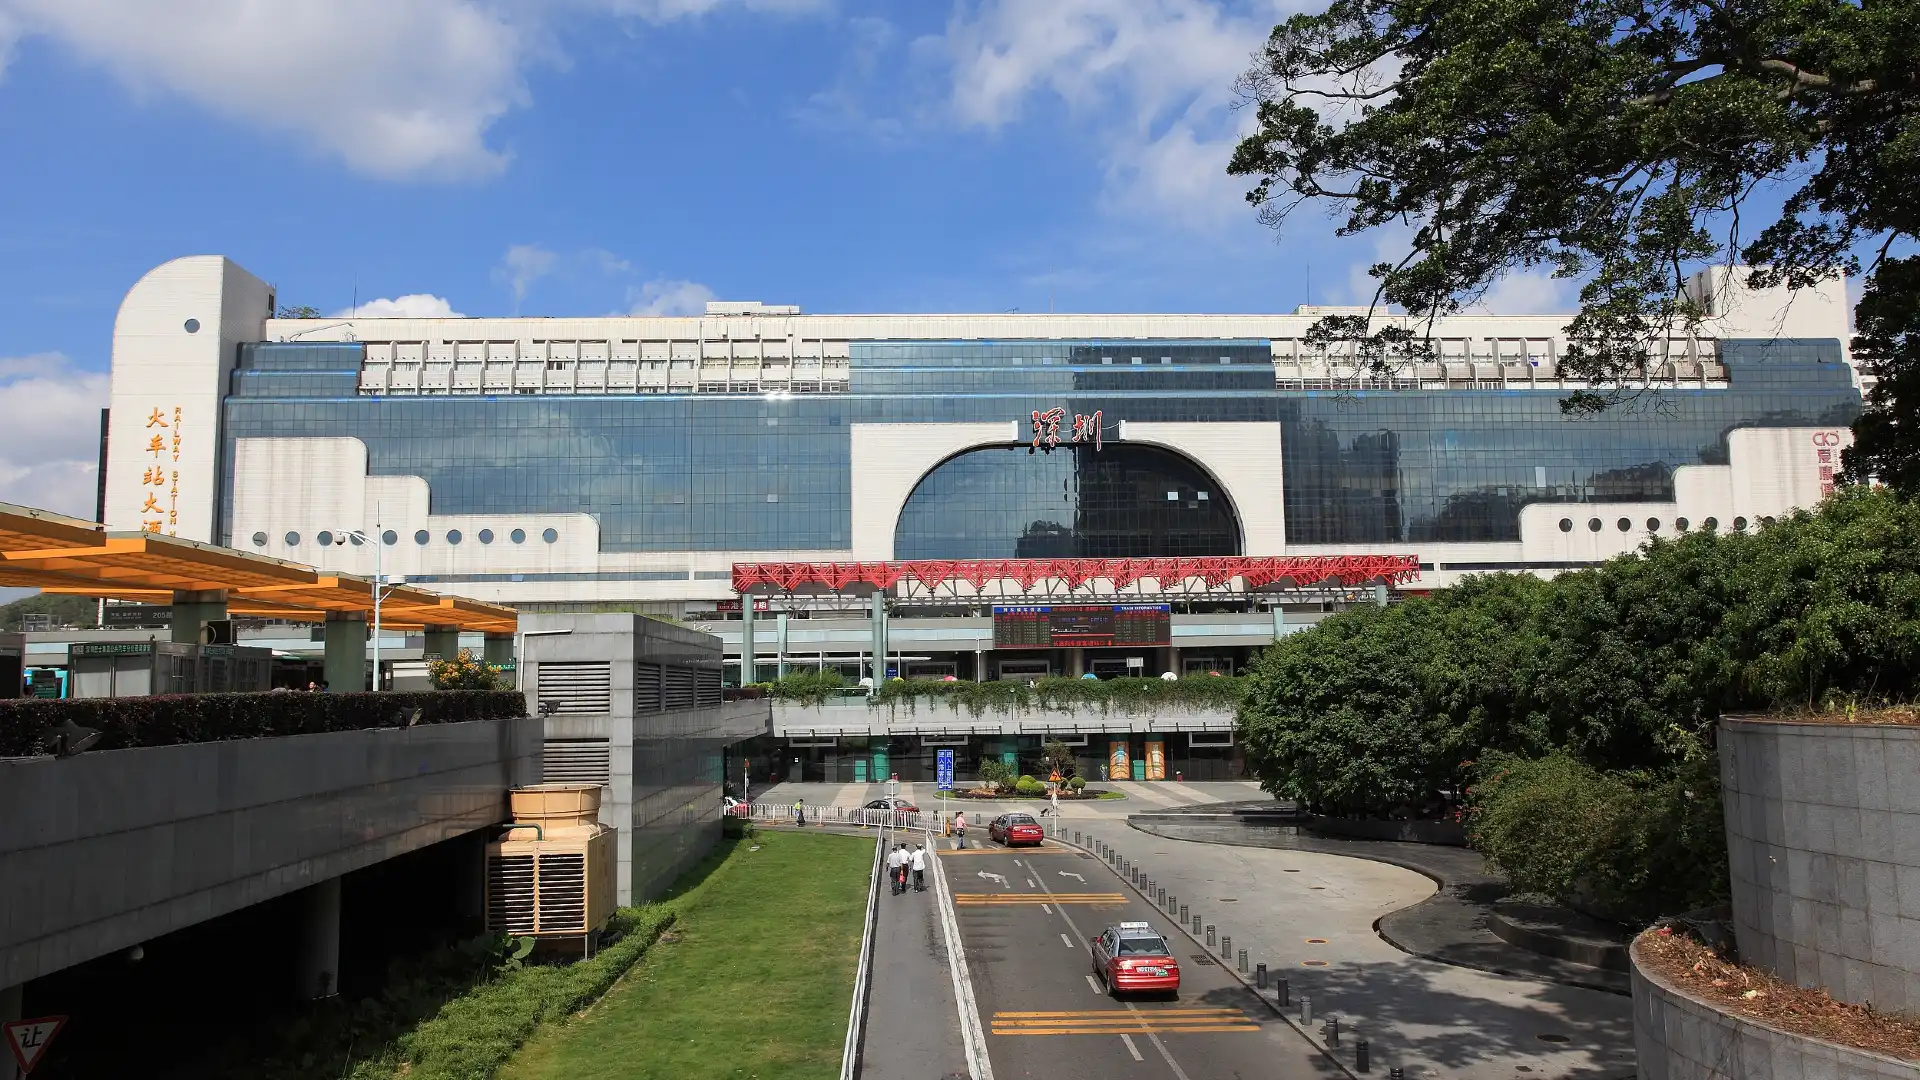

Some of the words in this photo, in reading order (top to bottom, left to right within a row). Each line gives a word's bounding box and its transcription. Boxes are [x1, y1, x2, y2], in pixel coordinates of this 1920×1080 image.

[173, 407, 181, 462] RAILWAY
[1032, 407, 1103, 452] 深圳
[168, 471, 179, 525] STATION
[20, 1025, 43, 1050] 让
